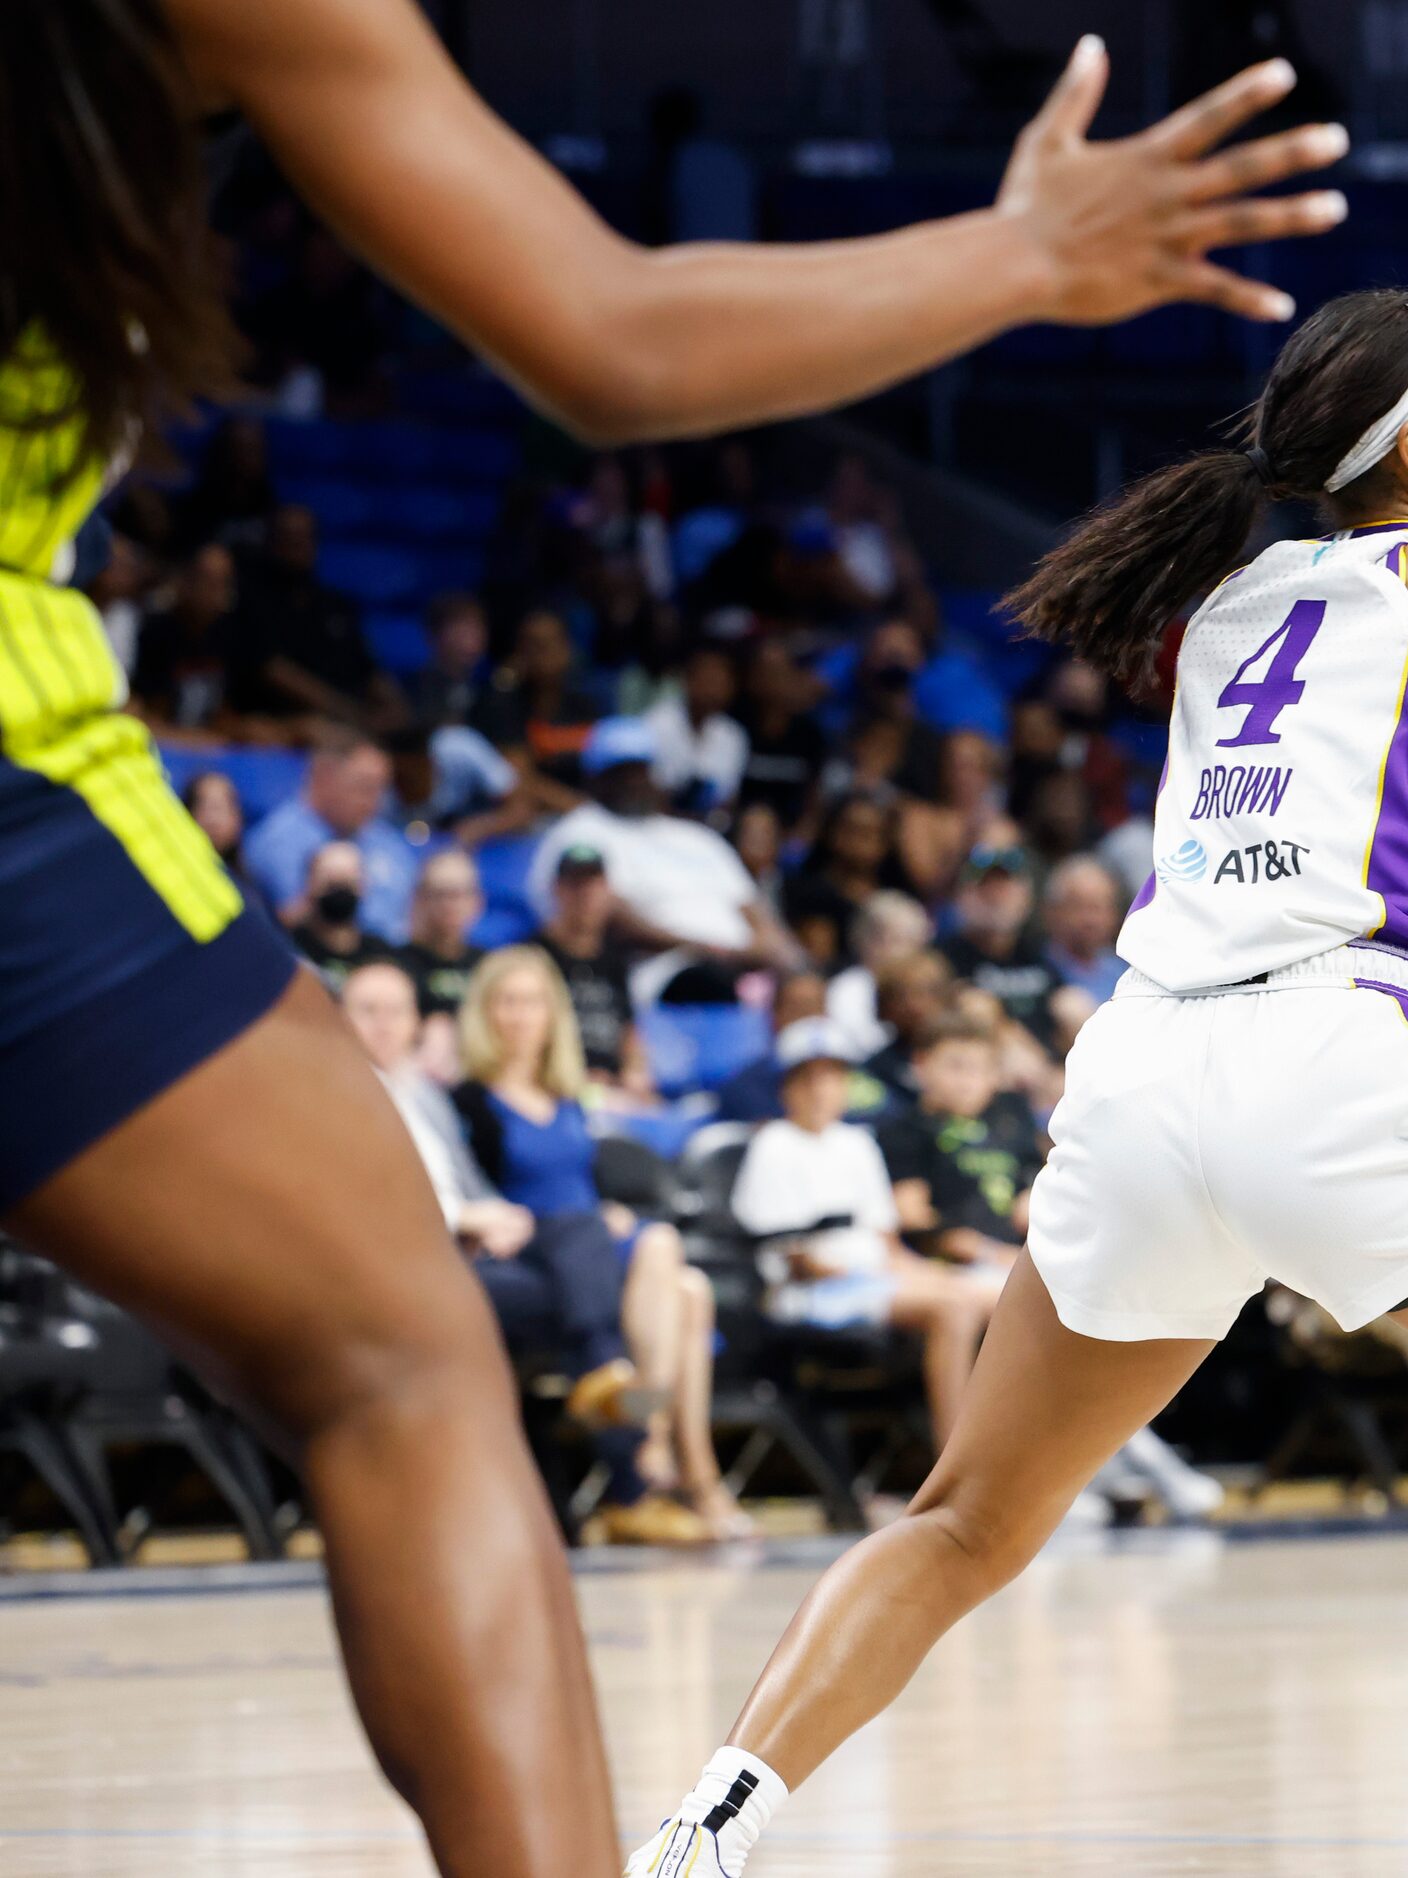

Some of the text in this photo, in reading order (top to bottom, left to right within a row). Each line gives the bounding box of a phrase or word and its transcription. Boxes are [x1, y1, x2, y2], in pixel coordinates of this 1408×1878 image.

[1215, 600, 1327, 747] 4
[1190, 764, 1293, 820] BROWN
[1213, 840, 1310, 884] AT&T
